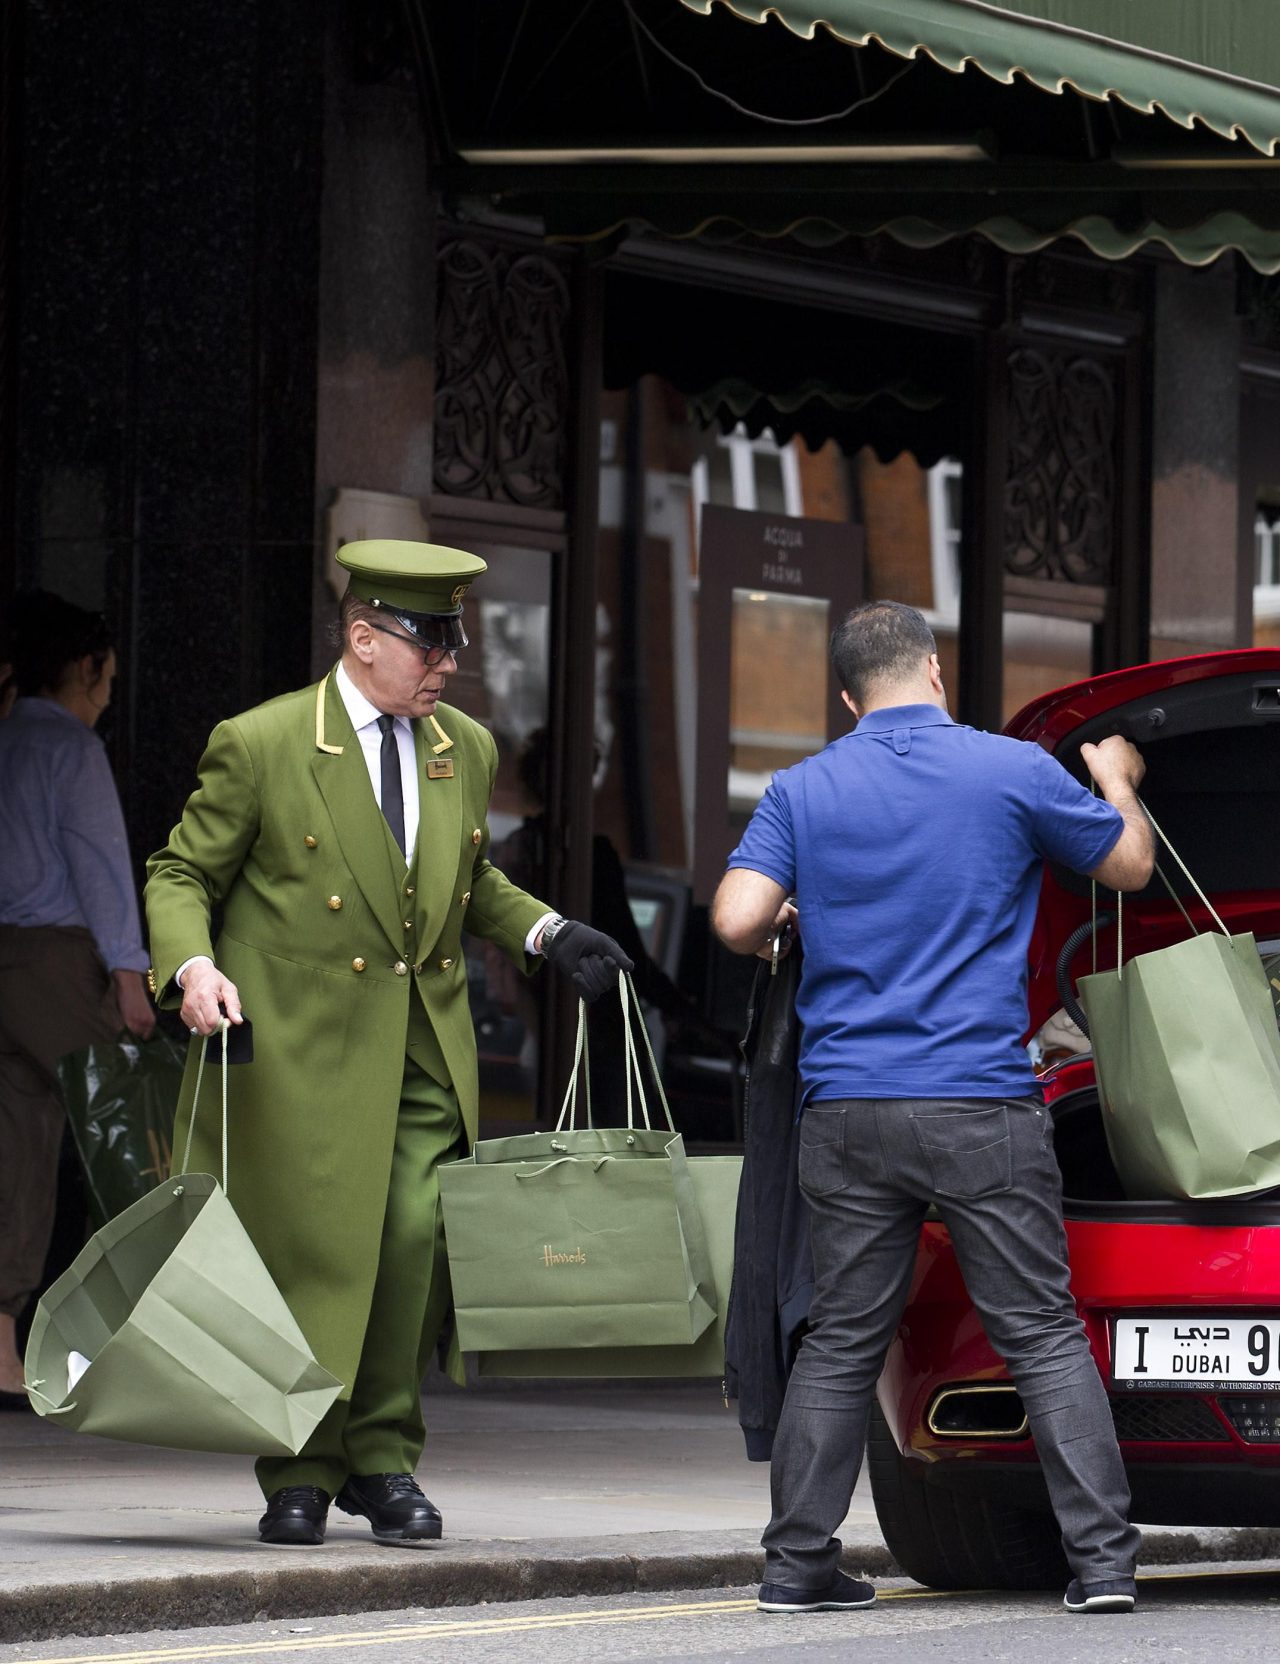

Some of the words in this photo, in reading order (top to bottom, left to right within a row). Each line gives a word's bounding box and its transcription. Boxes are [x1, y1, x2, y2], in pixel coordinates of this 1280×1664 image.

[763, 526, 804, 548] ACQUA
[762, 563, 803, 585] PARMA
[538, 1244, 586, 1267] Harrods
[1174, 1327, 1230, 1347] دبي
[1134, 1326, 1150, 1373] I
[1172, 1355, 1230, 1374] DUBAI
[1171, 1381, 1214, 1390] ENTERPRISES
[1219, 1382, 1262, 1390] AUTHORISED
